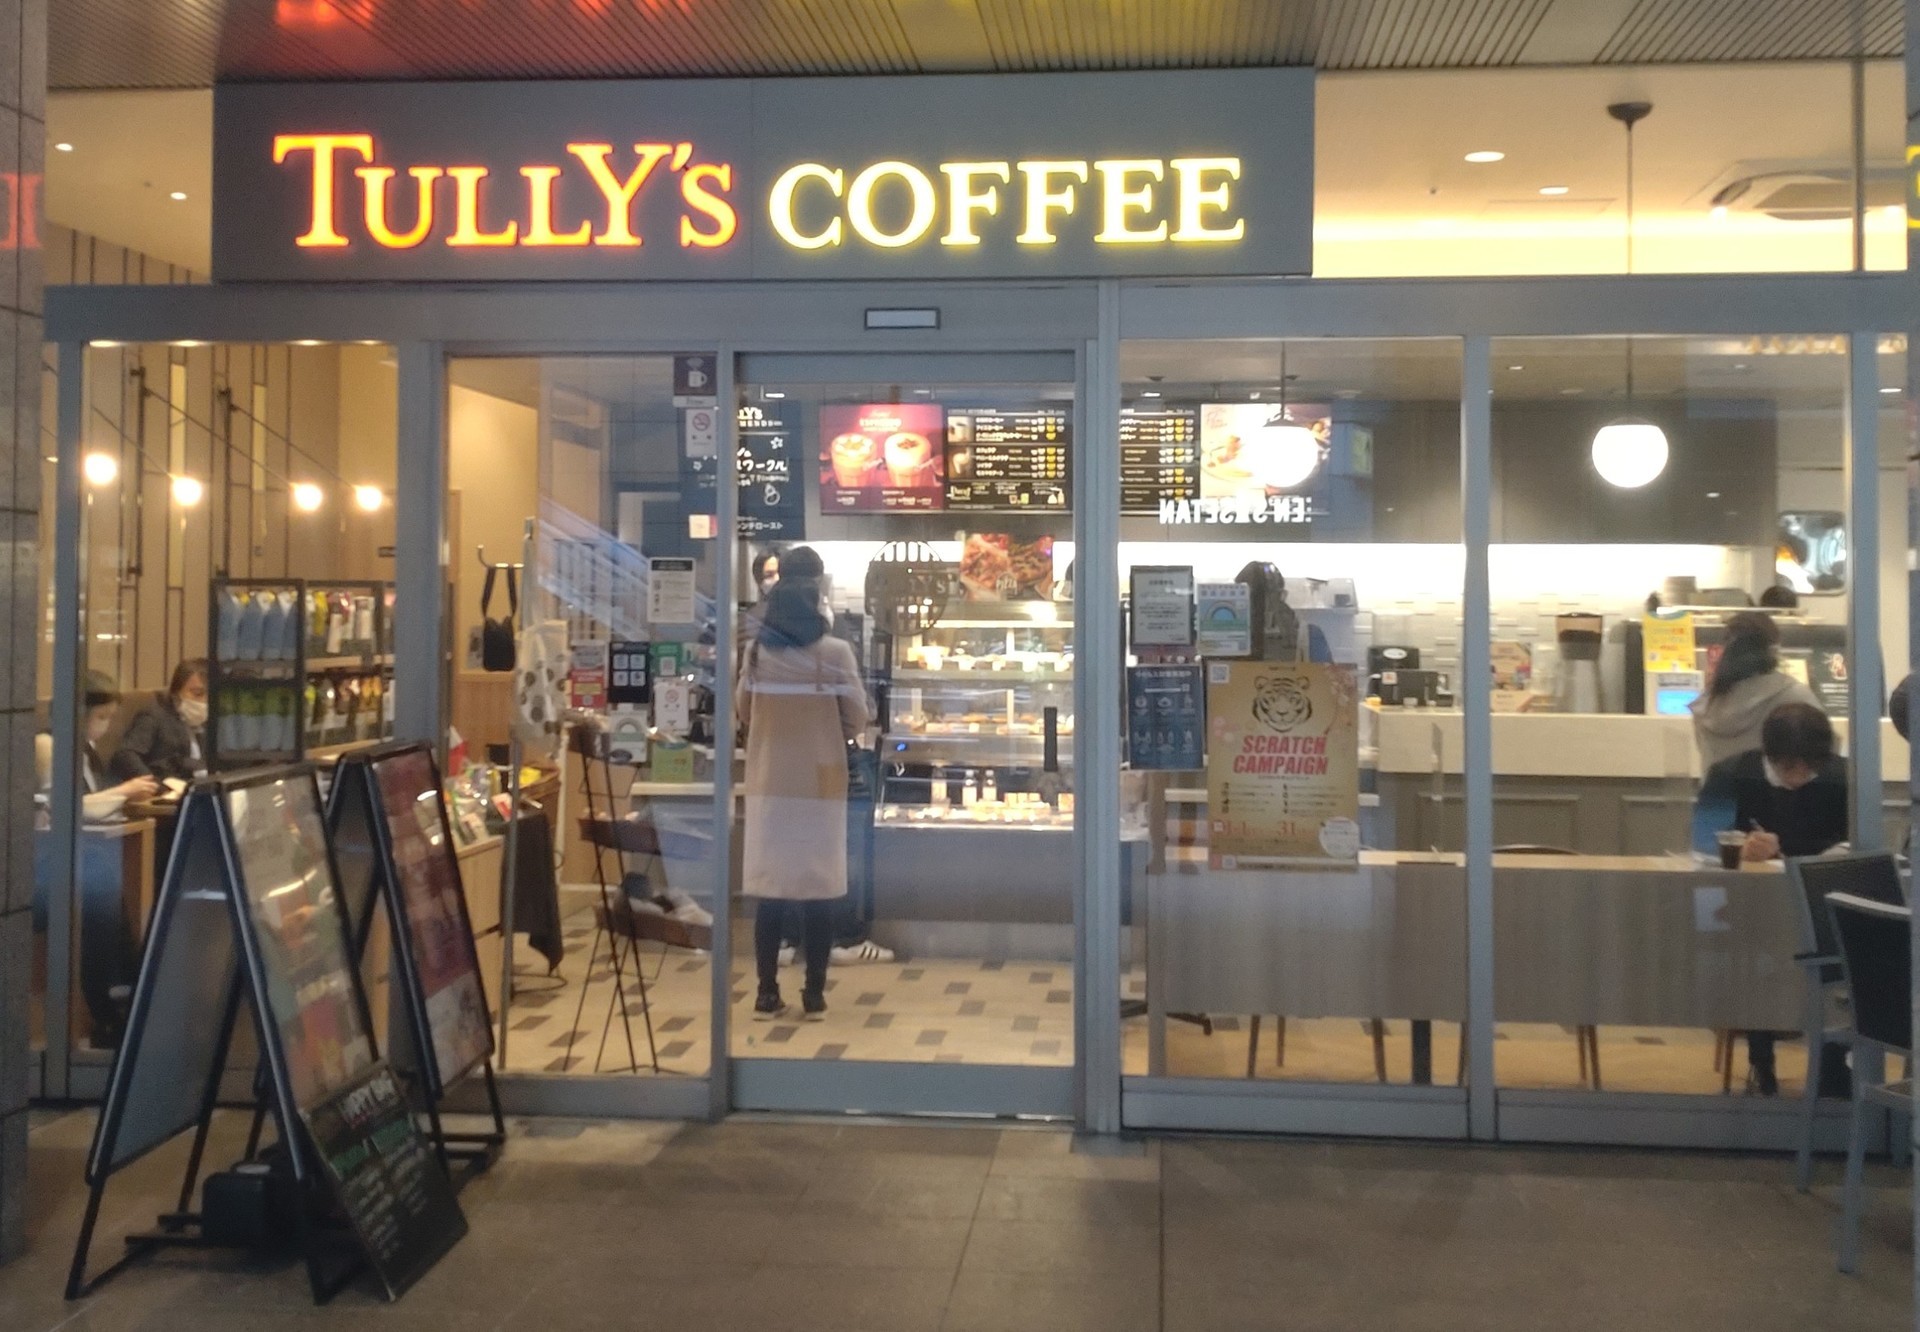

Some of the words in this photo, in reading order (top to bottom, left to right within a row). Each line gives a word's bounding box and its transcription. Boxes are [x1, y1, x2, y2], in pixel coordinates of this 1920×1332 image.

[273, 134, 738, 249] TULLY'S
[768, 157, 1246, 250] COFFEE
[1242, 735, 1327, 754] SCRATCH
[1233, 755, 1329, 774] CAMPAIGN
